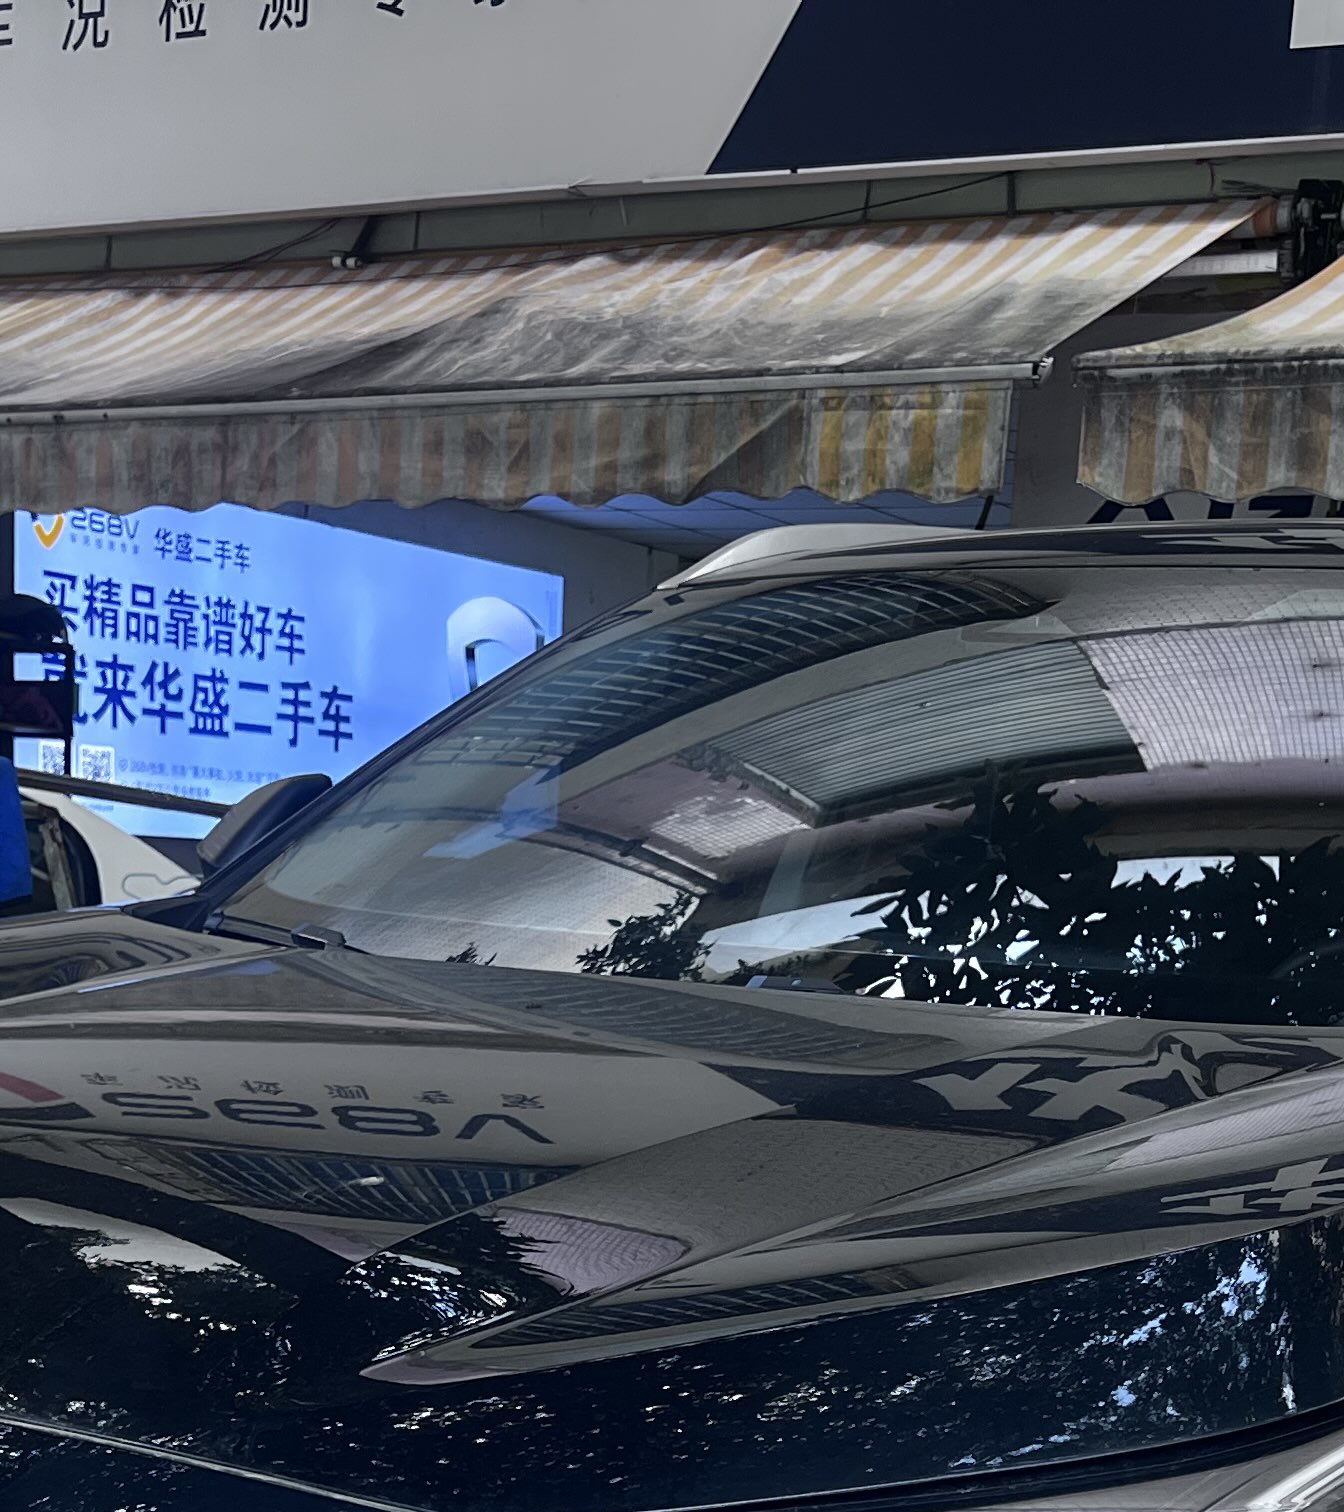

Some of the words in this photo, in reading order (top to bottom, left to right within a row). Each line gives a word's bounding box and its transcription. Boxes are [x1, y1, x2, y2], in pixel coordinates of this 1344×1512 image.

[154, 527, 252, 574] 华盛二手车
[42, 569, 307, 664] 买精品靠谱好车
